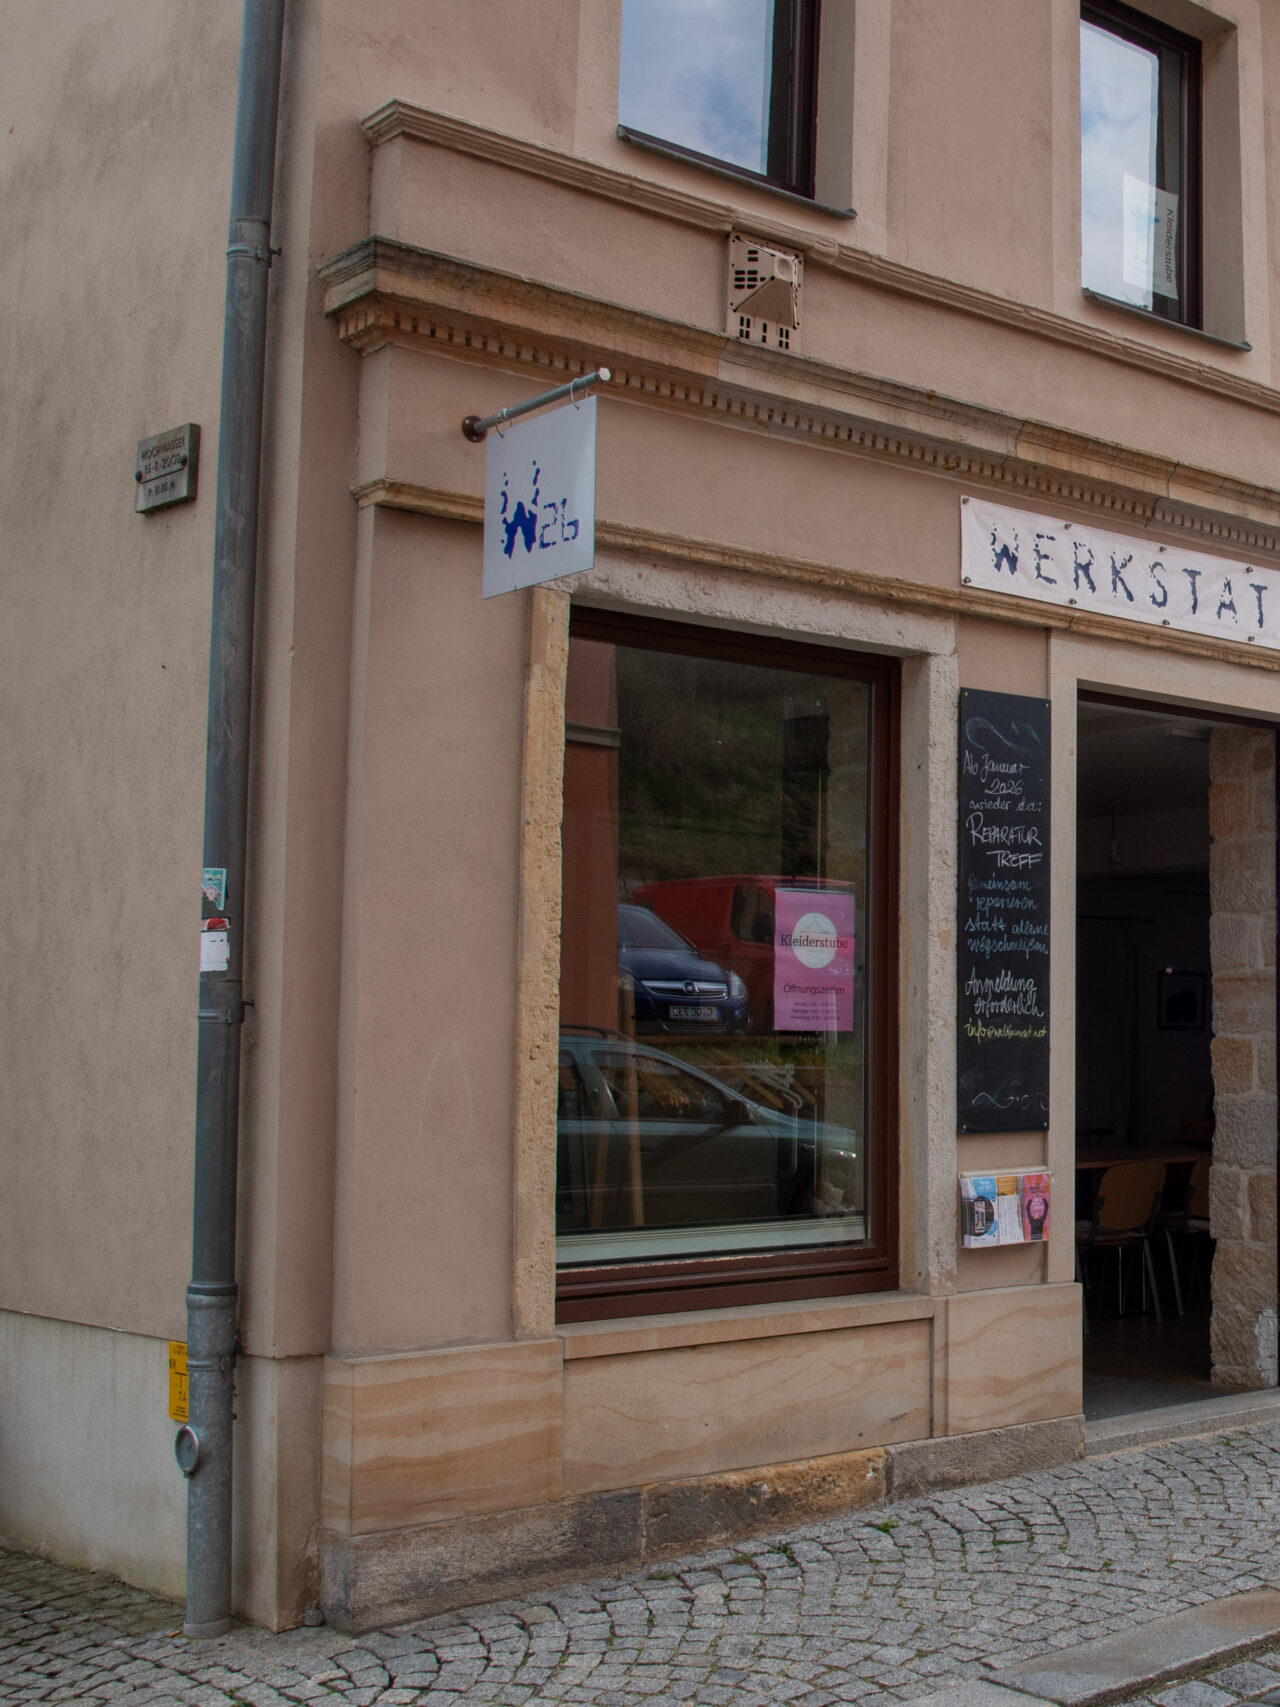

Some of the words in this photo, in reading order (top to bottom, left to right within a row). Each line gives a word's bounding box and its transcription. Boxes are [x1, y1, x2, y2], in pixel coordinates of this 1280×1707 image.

[1165, 208, 1175, 284] Kleiderstube
[141, 436, 186, 462] HOCHWASSER
[963, 749, 978, 775] Ab
[980, 753, 1030, 783] Januar
[984, 779, 1023, 796] 2026
[969, 798, 1010, 811] wieder
[1016, 796, 1043, 812] da:
[965, 811, 1043, 846] REPARATUR
[986, 850, 1043, 869] TREFF
[968, 872, 1032, 892] Gemeinsam
[976, 891, 1038, 918] reparieren
[964, 912, 1007, 932] statt
[1011, 920, 1049, 936] alleine
[780, 933, 849, 949] Kleiderstube
[783, 983, 845, 996] Öffnungszeiten
[965, 965, 1038, 1000] Anmeldung
[973, 992, 1045, 1018] erforderlich
